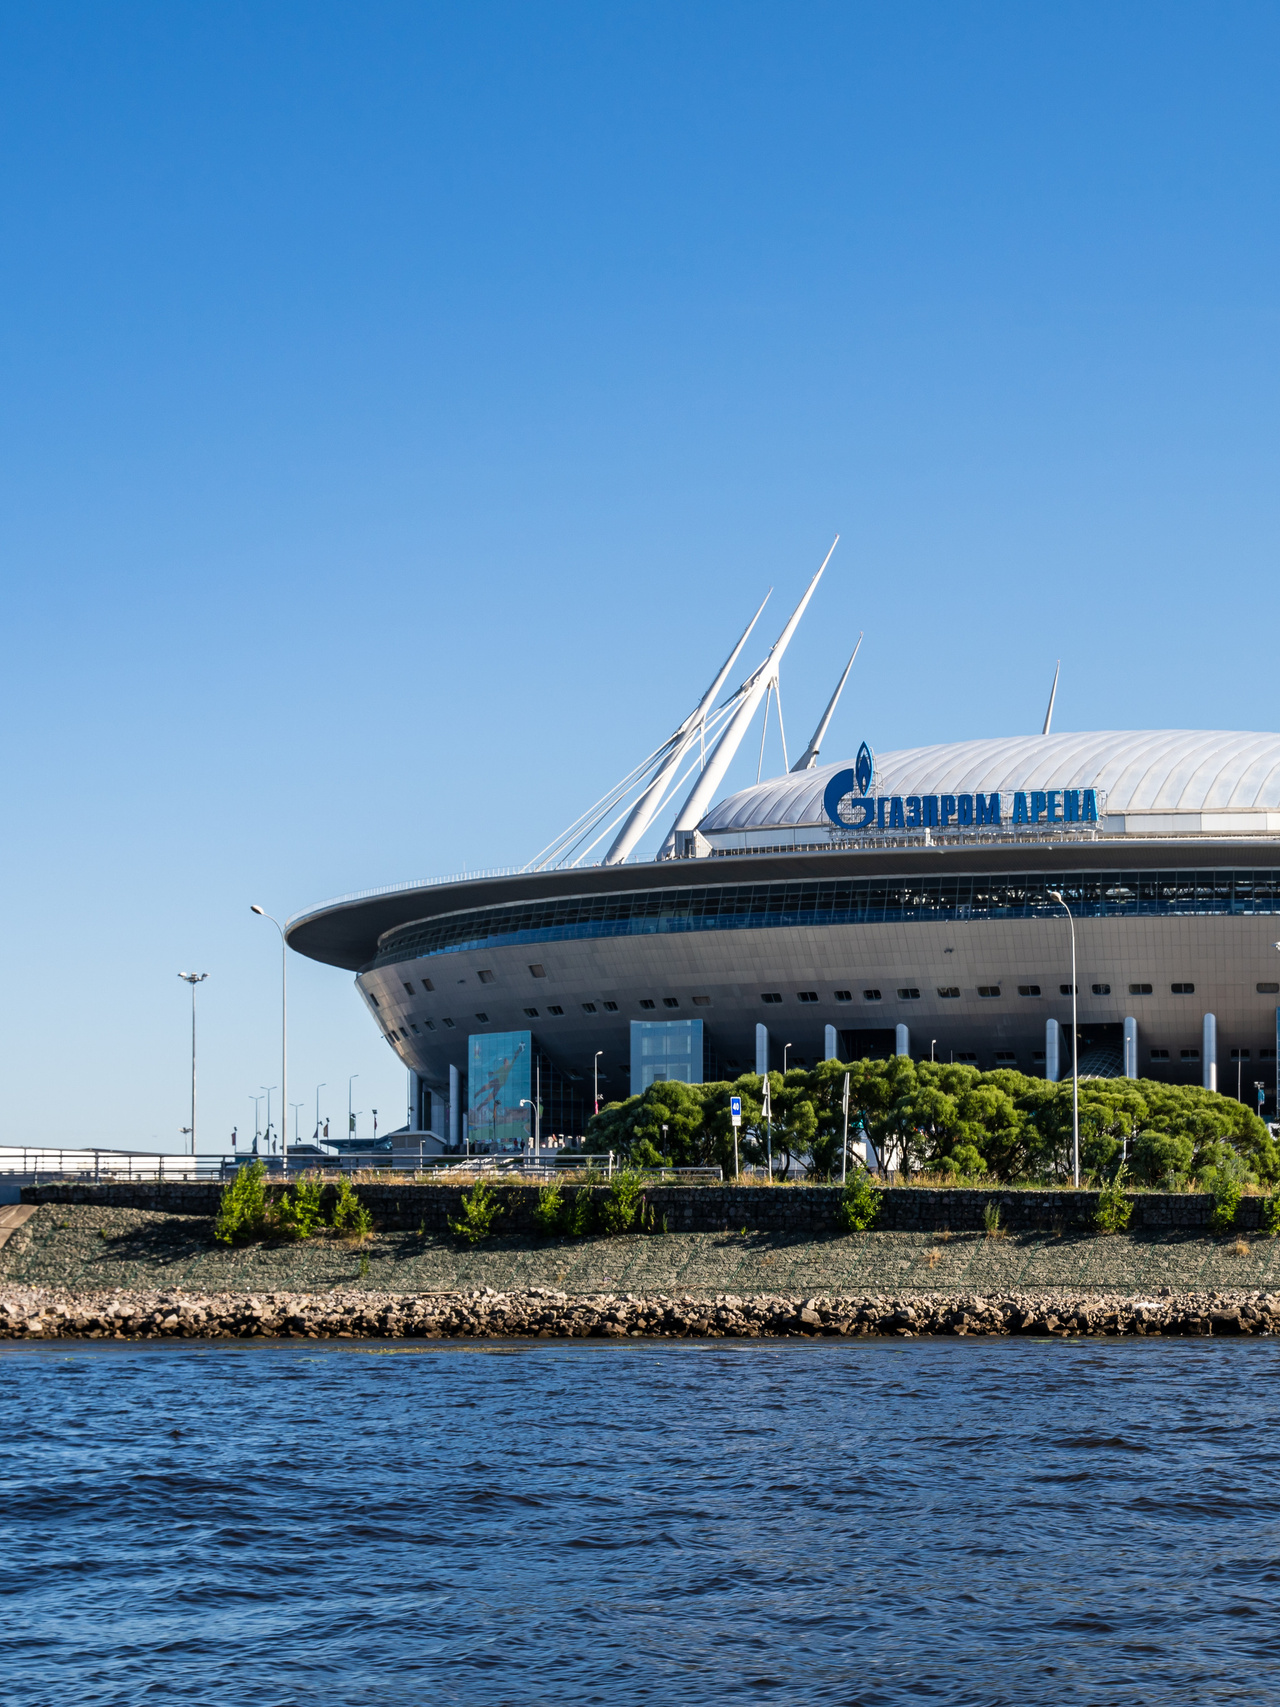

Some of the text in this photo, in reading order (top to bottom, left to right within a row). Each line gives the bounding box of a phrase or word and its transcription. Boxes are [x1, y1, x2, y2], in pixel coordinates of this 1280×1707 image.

[877, 789, 1099, 829] ГАЗПРОМ АРЕНА
[732, 1102, 740, 1111] 40
